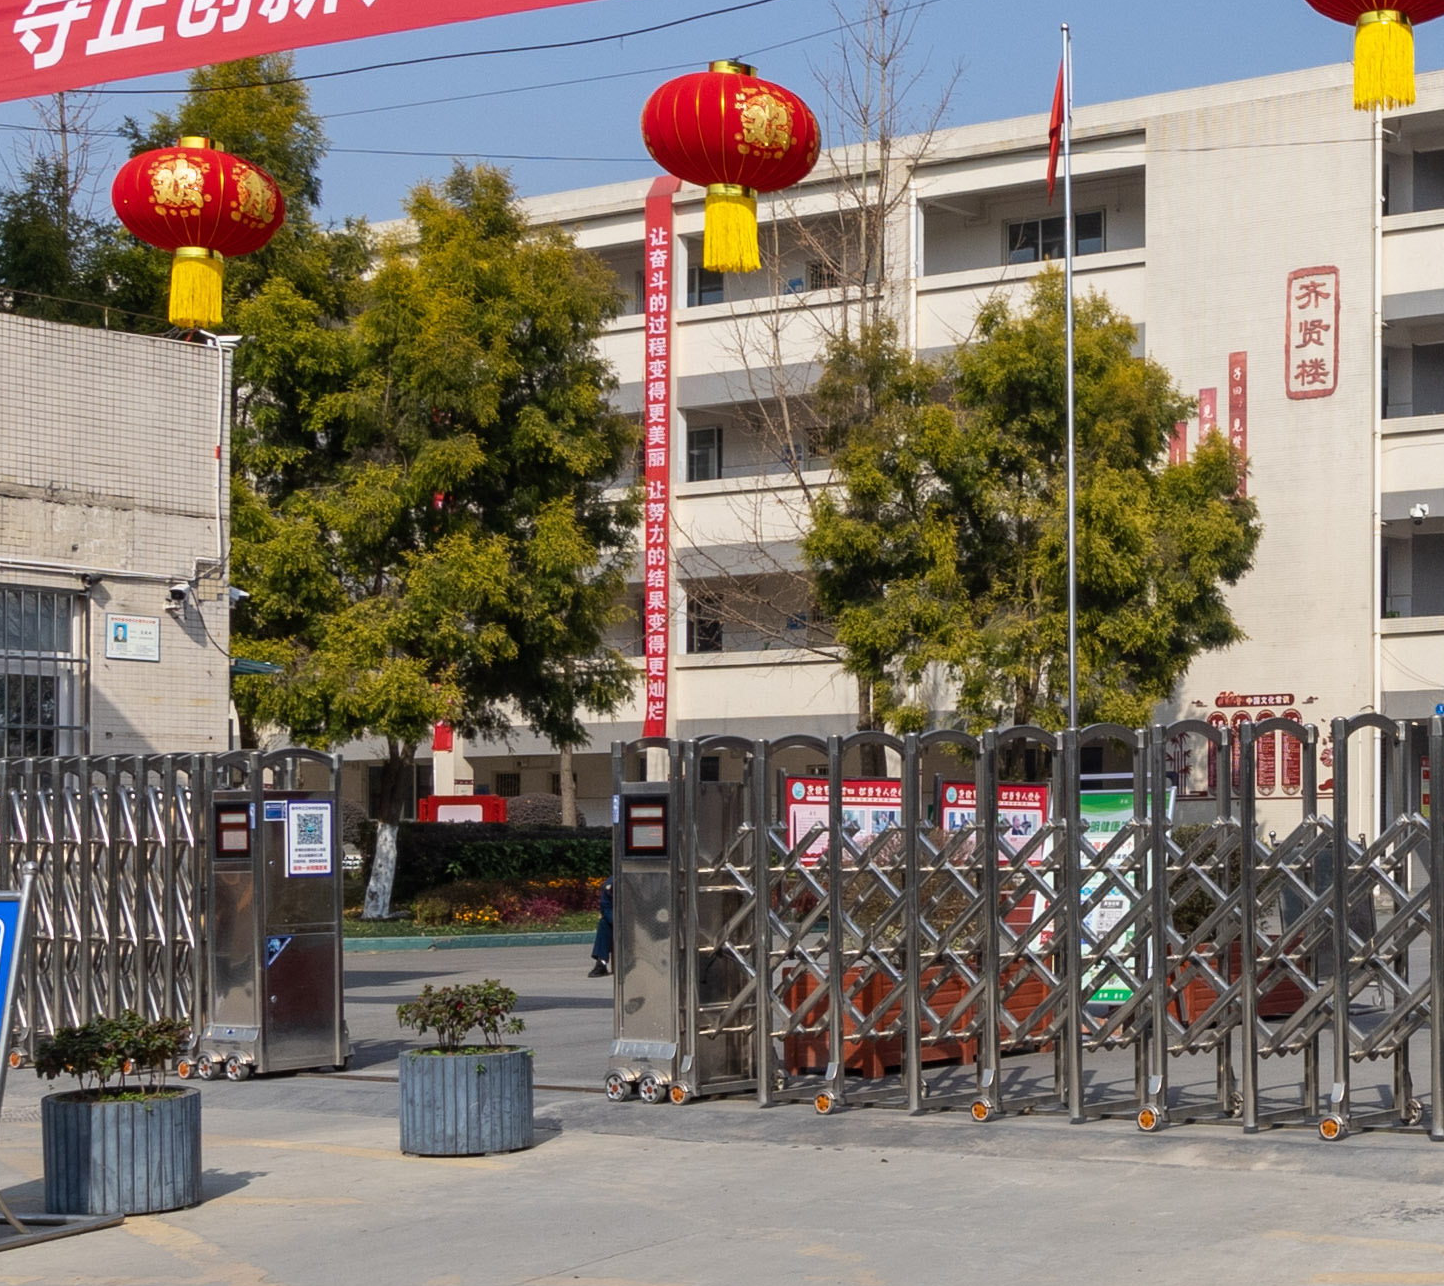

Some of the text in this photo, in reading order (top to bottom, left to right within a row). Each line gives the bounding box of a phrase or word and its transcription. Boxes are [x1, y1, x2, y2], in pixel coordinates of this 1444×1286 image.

[646, 226, 668, 721] 让奋斗的过程变得更美丽 让努力的结果变得更灿烂
[1294, 278, 1332, 387] 齐贤楼
